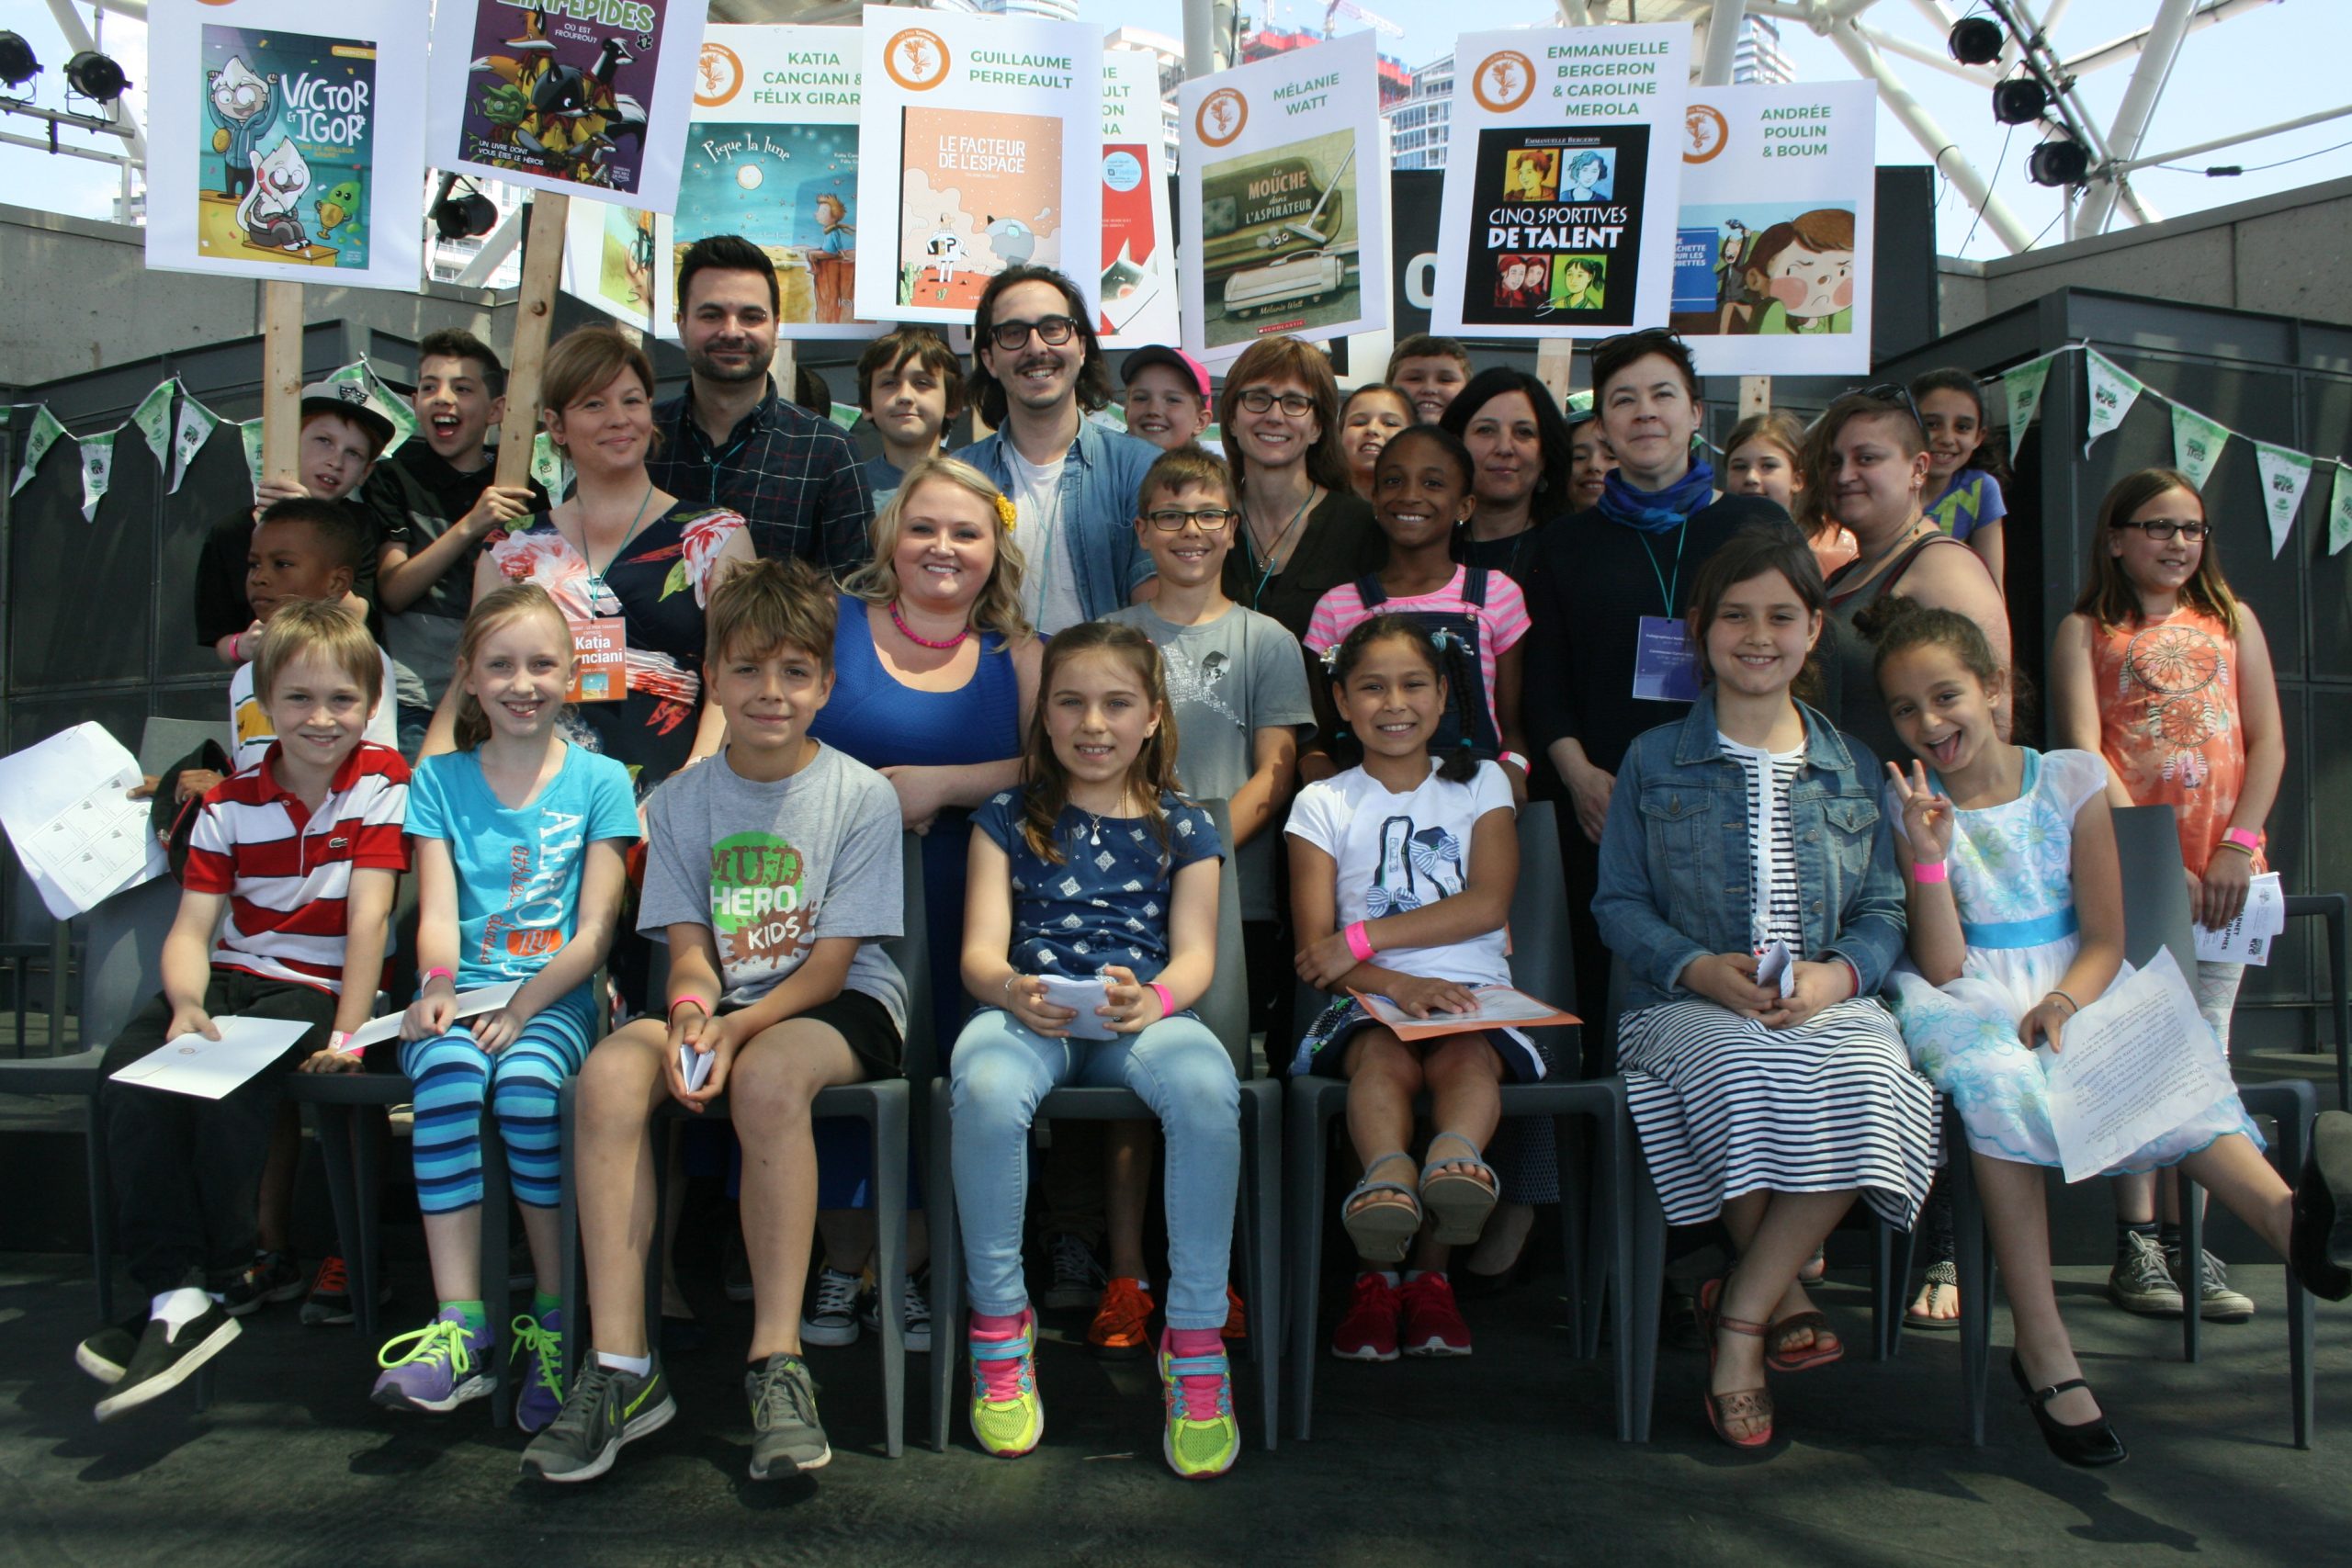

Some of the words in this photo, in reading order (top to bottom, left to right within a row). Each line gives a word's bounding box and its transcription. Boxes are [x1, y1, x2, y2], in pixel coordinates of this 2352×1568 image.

[555, 28, 597, 44] FROUFROU?
[579, 26, 591, 34] EST
[788, 52, 841, 65] KATIA
[1547, 41, 1669, 59] EMMANUELLE
[970, 51, 1072, 70] GUILLAUME
[1557, 62, 1656, 78] BERGERON
[763, 72, 849, 85] CANCIANI
[969, 69, 1073, 89] PERREAULT
[1273, 73, 1340, 101] MÉLANIE
[281, 73, 369, 114] VICTOR
[753, 87, 802, 105] FÉLIX
[807, 92, 861, 106] GIRAR
[1553, 85, 1563, 97] &
[1567, 81, 1657, 97] CAROLINE
[1285, 94, 1329, 117] WATT
[1566, 103, 1639, 117] MEROLA
[1761, 104, 1831, 121] ANDRÉE
[287, 111, 297, 123] ET
[296, 108, 365, 147] IGOR
[1764, 125, 1826, 139] POULIN
[479, 148, 496, 156] VOUS
[492, 142, 507, 151] LIVRE
[510, 146, 528, 154] DONT
[702, 140, 742, 164] Pique
[747, 133, 759, 152] la
[764, 136, 790, 163] lune
[939, 135, 957, 152] LE
[959, 136, 1025, 157] FACTEUR
[1762, 147, 1773, 157] &
[1777, 144, 1827, 158] BOUM
[939, 152, 957, 169] DE
[960, 154, 1025, 174] L'ESPACE
[1249, 170, 1307, 200] MOUCHE
[1269, 195, 1287, 206] dans
[1246, 198, 1312, 224] L'ASPIRATEUR
[1488, 208, 1535, 226] CINQ
[1539, 207, 1628, 224] SPORTIVES
[1487, 227, 1521, 249] DE
[1527, 226, 1623, 250] TALENT
[1676, 244, 1706, 253] CHETTE
[575, 635, 611, 649] Katia
[582, 649, 623, 664] nciani
[710, 845, 804, 888] MUD
[710, 885, 797, 916] HERO
[2233, 909, 2244, 936] ARNET
[748, 917, 801, 950] KIDS
